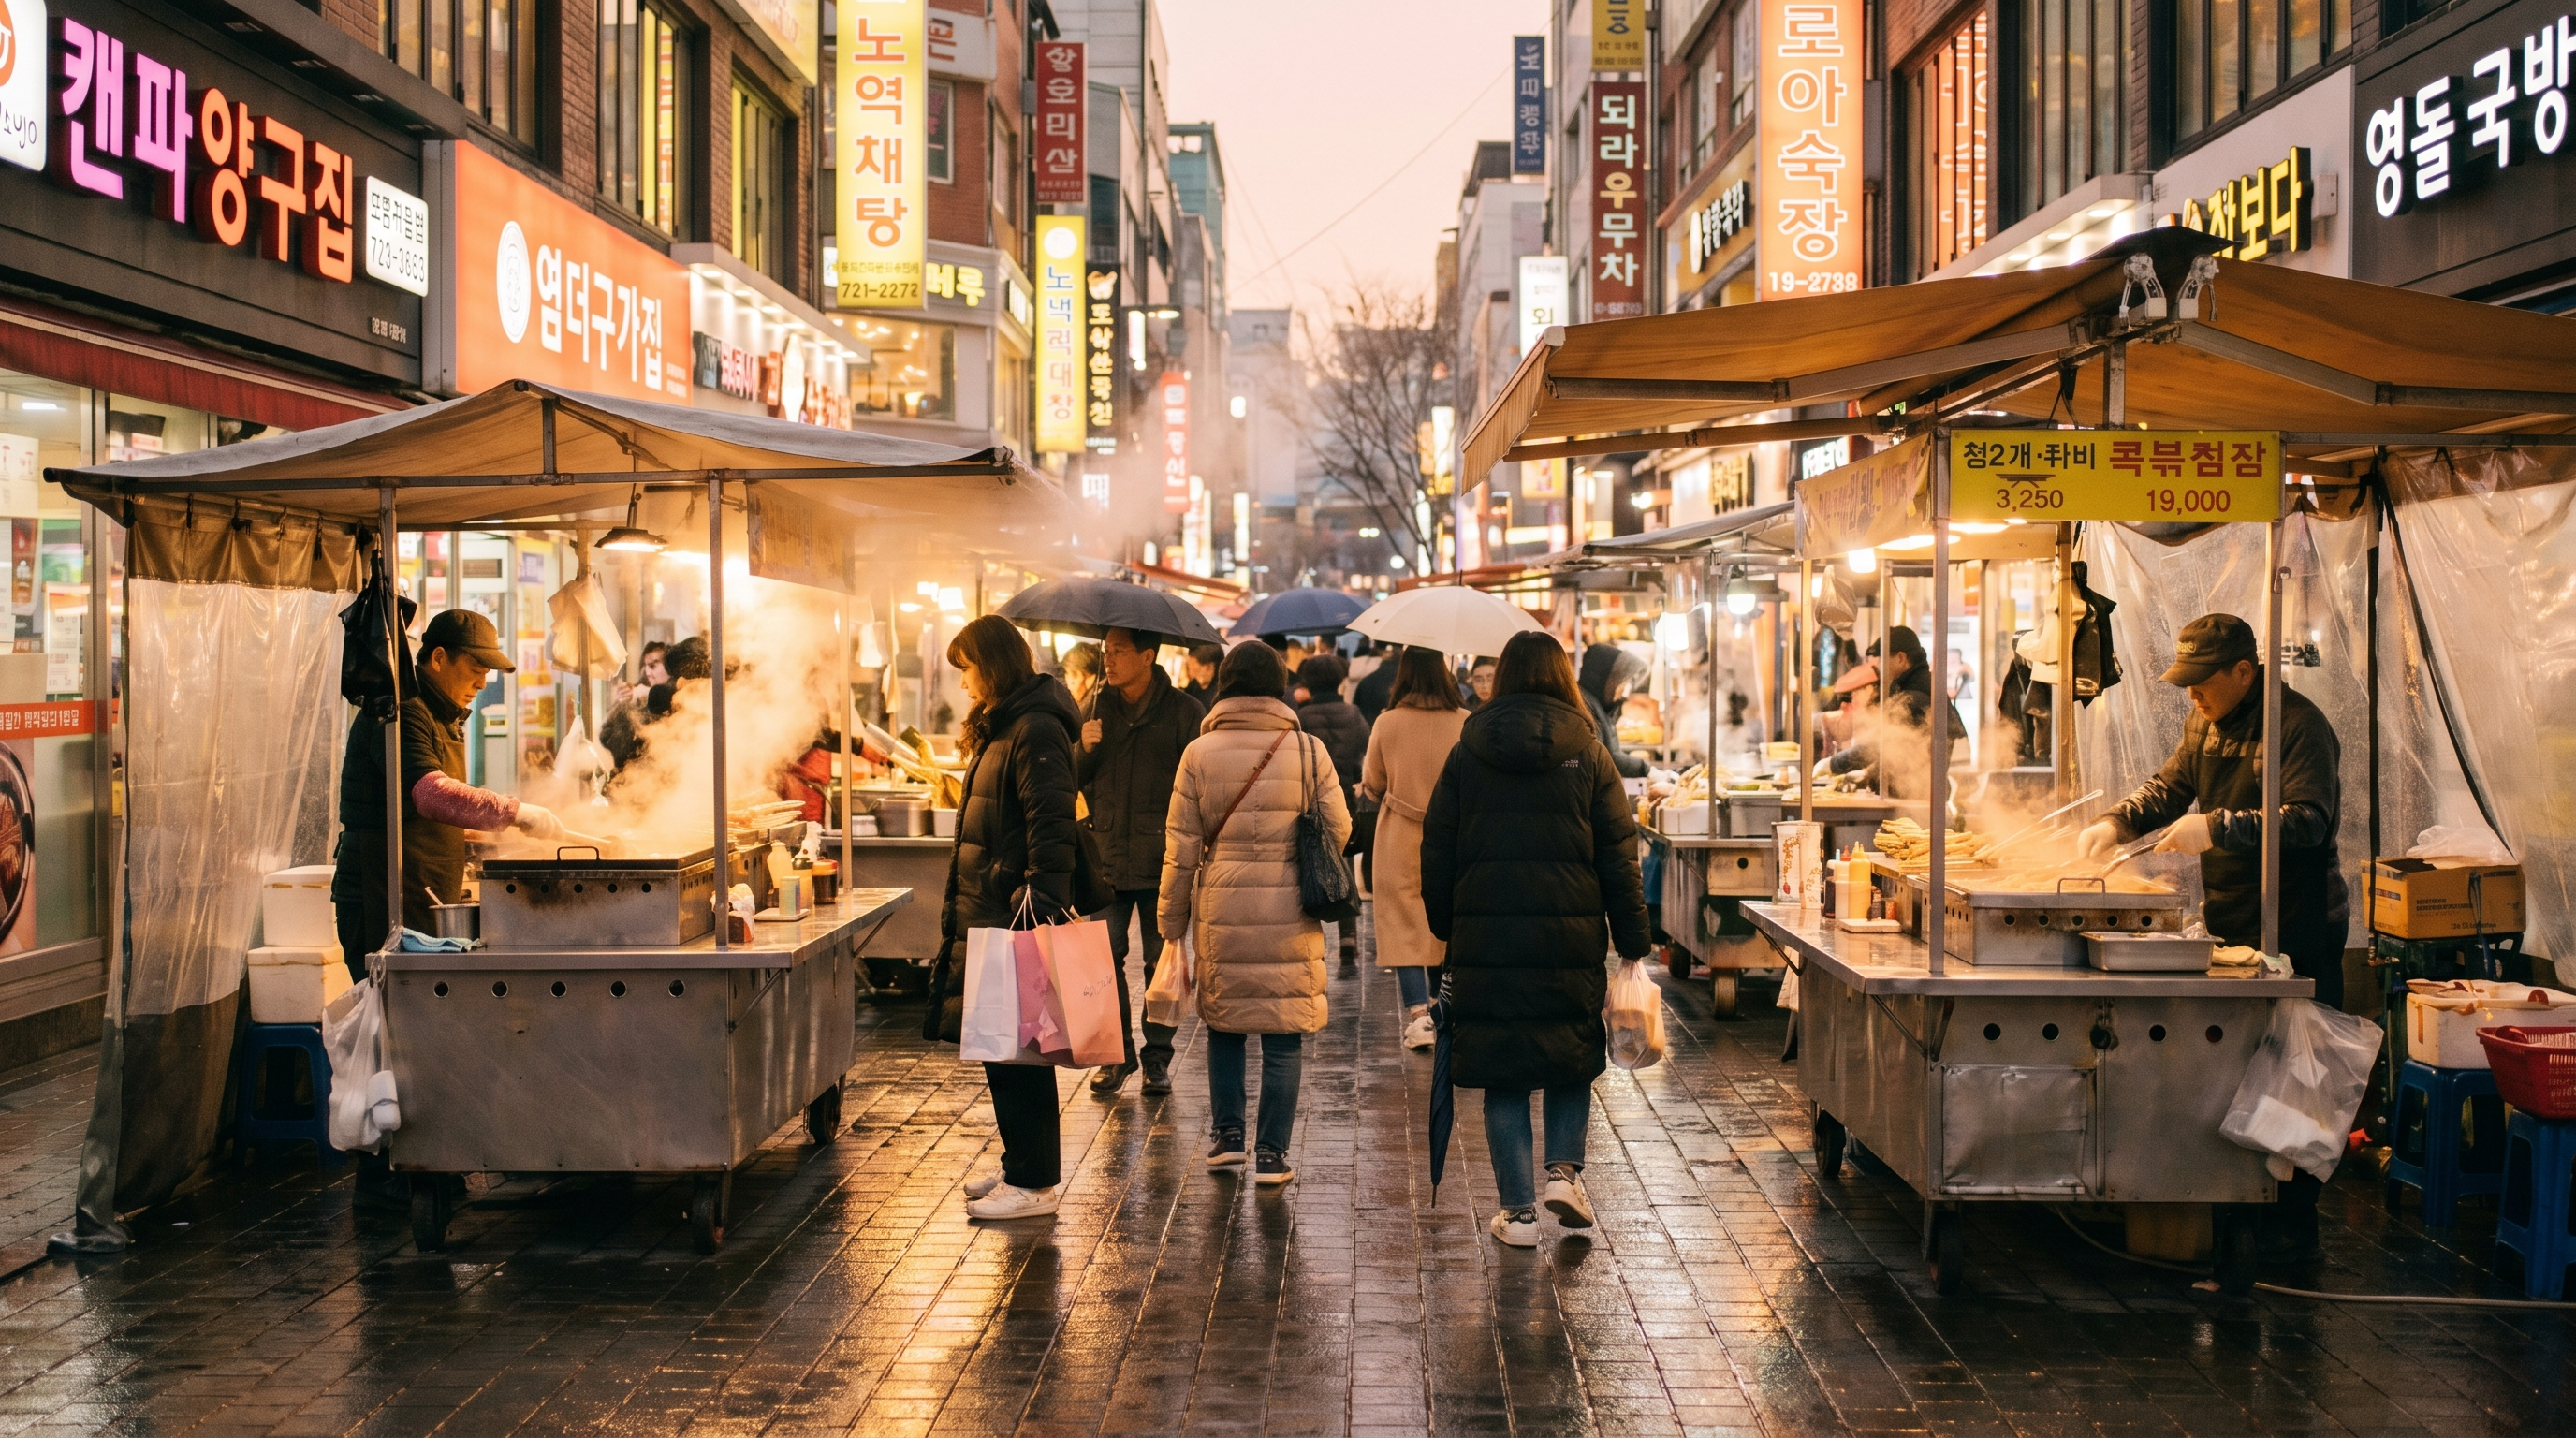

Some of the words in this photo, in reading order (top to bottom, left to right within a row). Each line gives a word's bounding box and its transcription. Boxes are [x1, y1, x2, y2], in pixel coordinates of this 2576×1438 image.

[854, 18, 908, 248] 노역채탕
[1599, 94, 1640, 287] 되라우무차
[1778, 4, 1848, 263] 로아숙장
[536, 244, 662, 392] 염더구가집
[1996, 490, 2064, 512] 3,250
[2146, 489, 2231, 515] 19,000
